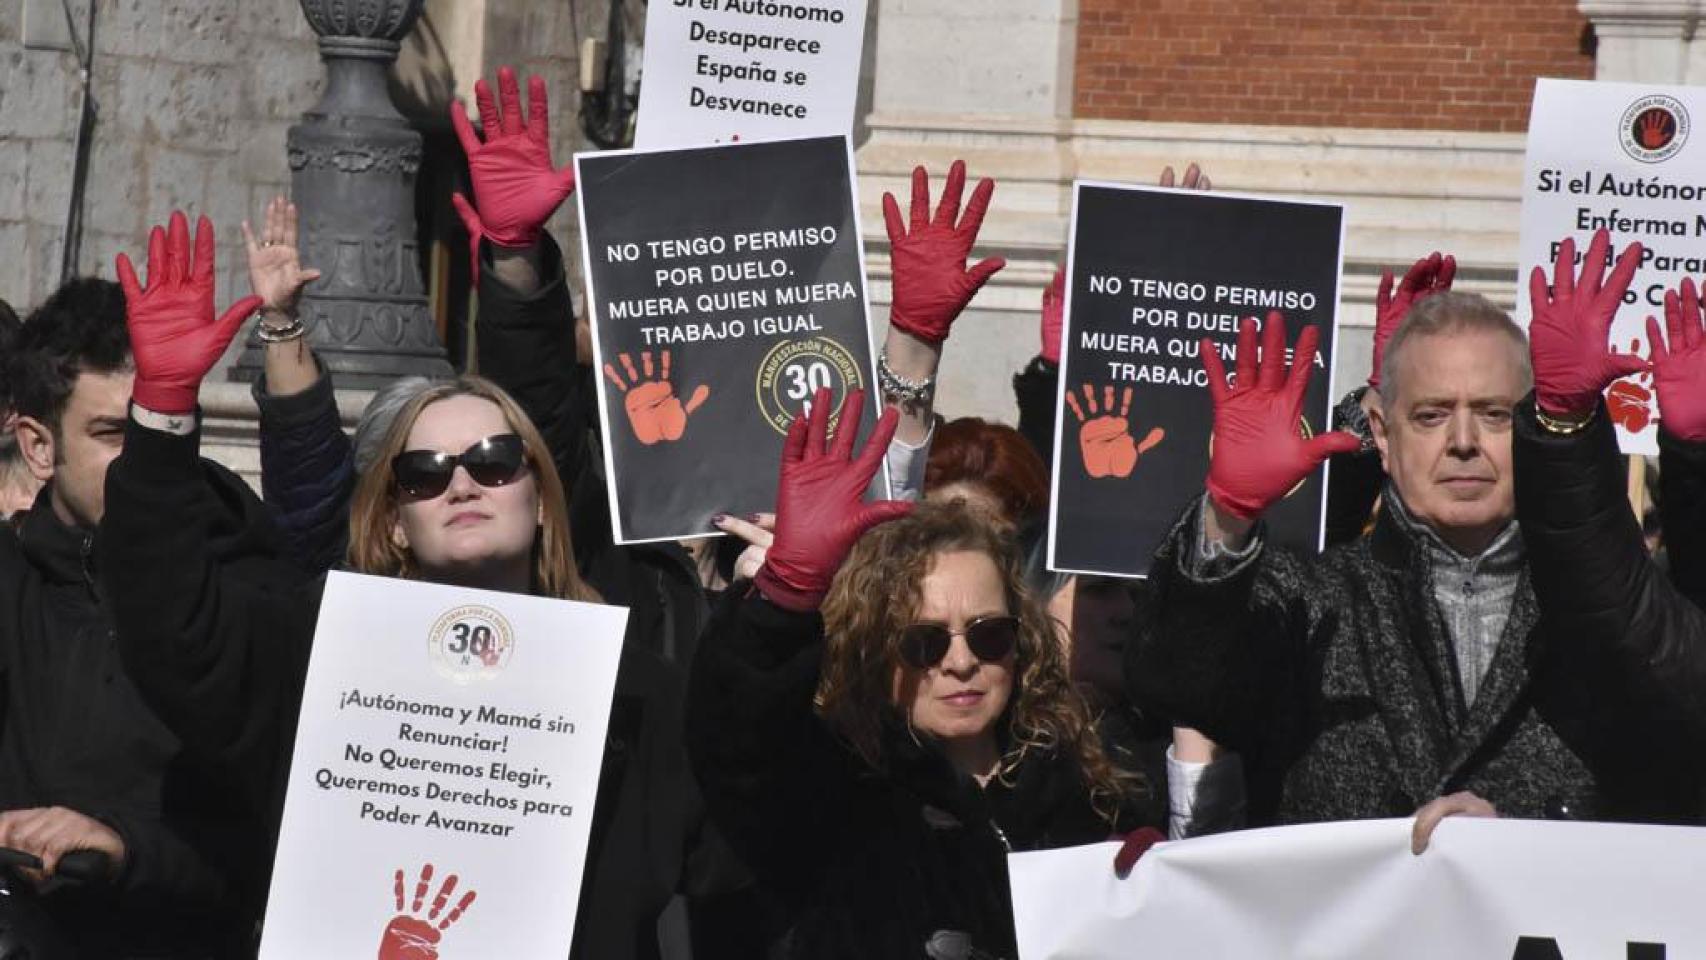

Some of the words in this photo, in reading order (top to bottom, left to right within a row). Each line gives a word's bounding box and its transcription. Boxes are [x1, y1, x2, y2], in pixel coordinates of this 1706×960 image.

[690, 20, 821, 54] Desaparece
[697, 55, 776, 83] España
[784, 70, 807, 86] se
[690, 87, 807, 119] Desvanece
[1537, 169, 1561, 193] Si
[1568, 171, 1592, 194] el
[1577, 207, 1687, 236] Enferma
[607, 244, 639, 262] NO
[648, 236, 726, 259] TENGO
[734, 226, 837, 251] PERMISO
[1640, 246, 1706, 273] Para
[656, 267, 702, 287] POR
[711, 259, 794, 282] DUELO.
[609, 299, 689, 320] MUERA
[697, 290, 768, 313] QUIEN
[776, 282, 856, 305] MUERA
[1090, 276, 1122, 295] NO
[1130, 278, 1206, 301] TENGO
[1215, 286, 1316, 310] PERMISO
[642, 320, 745, 345] TRABAJO
[754, 314, 823, 336] IGUAL
[1132, 307, 1179, 328] POR
[1081, 332, 1159, 355] MUERA
[1167, 339, 1237, 361] QUN
[785, 361, 831, 399] 30
[1108, 362, 1209, 387] TRABAJO
[448, 622, 491, 656] 30
[339, 688, 453, 719] ¡Autónoma
[459, 708, 472, 725] y
[477, 705, 541, 730] Mamá
[547, 715, 575, 735] sin
[399, 723, 510, 754] Renunciar!
[344, 744, 374, 763] No
[379, 749, 484, 779] Queremos
[489, 762, 553, 790] Elegir,
[315, 768, 420, 798] Queremos
[426, 782, 518, 811] Derechos
[523, 799, 574, 818] para
[360, 801, 421, 826] Poder
[425, 811, 515, 838] Avanzar
